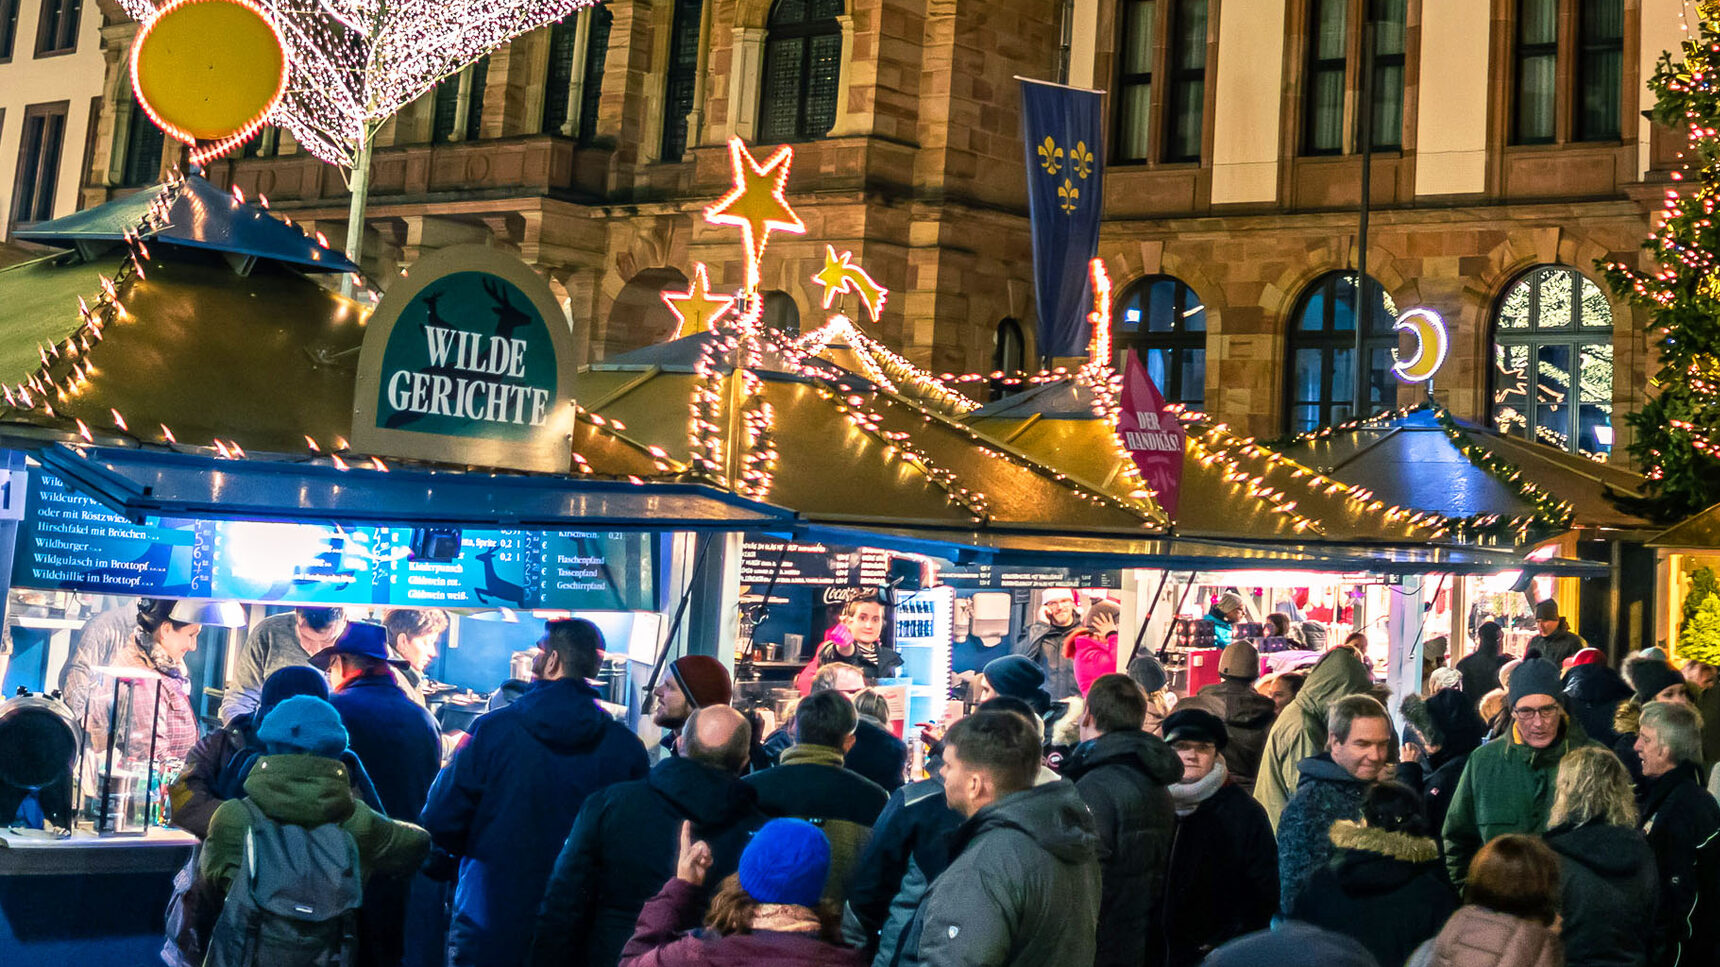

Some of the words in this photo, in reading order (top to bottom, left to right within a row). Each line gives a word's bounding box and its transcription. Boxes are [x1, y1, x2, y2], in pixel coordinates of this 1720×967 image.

[424, 325, 527, 378] WILDE
[387, 369, 549, 427] GERICHTE
[1136, 411, 1160, 430] DER
[1126, 430, 1181, 451] HANDKÄS!
[37, 507, 60, 519] oder
[62, 509, 78, 520] mit
[91, 527, 105, 537] mit
[108, 527, 146, 540] Brötchen
[35, 537, 90, 552] Wildburger
[34, 552, 93, 568] Wildgulasch
[95, 557, 108, 568] im
[111, 559, 149, 573] Brottopf
[32, 568, 85, 582] Wildchillie
[87, 572, 101, 583] im
[103, 573, 142, 587] Brottopf
